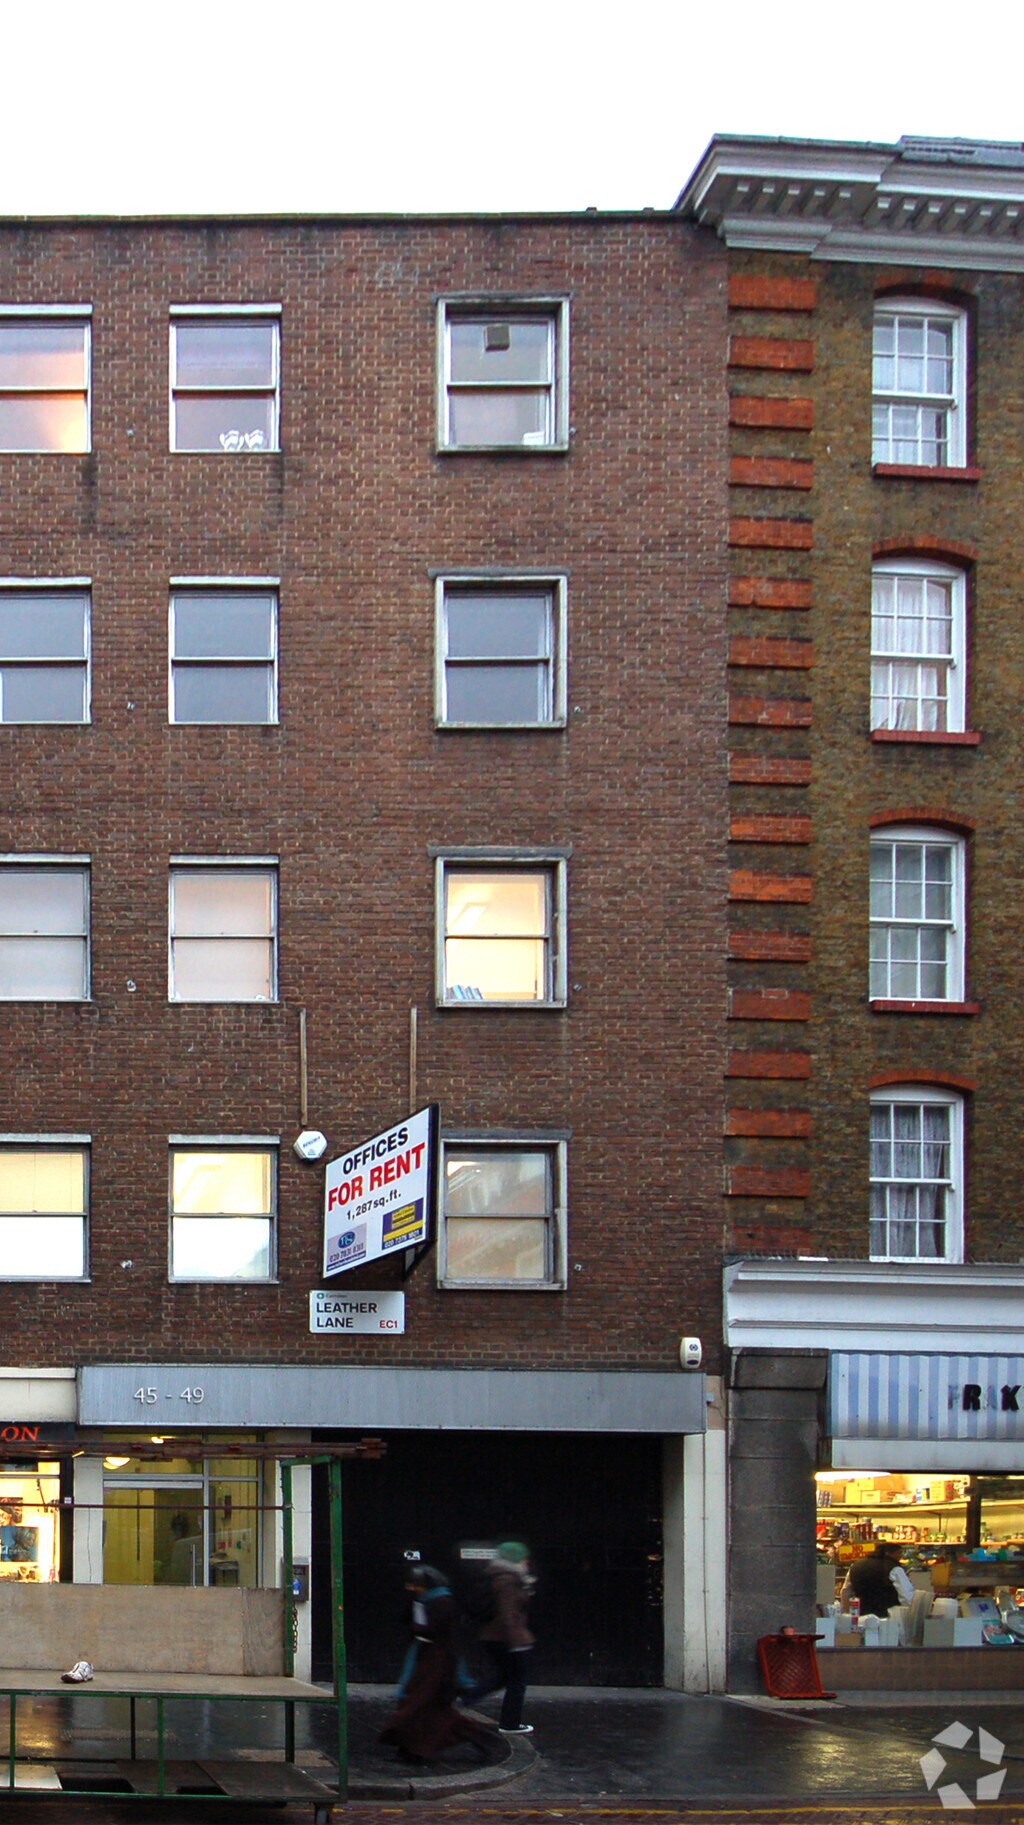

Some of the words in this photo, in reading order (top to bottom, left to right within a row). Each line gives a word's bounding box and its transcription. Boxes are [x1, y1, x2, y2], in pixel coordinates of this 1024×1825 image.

[343, 1127, 408, 1175] OFFICES
[328, 1175, 363, 1212] FOR
[369, 1142, 425, 1192] RENT
[316, 1303, 378, 1313] LEATHER
[316, 1317, 354, 1328] LANE
[379, 1320, 398, 1329] EC1
[133, 1386, 158, 1404] 45
[179, 1386, 205, 1404] 49
